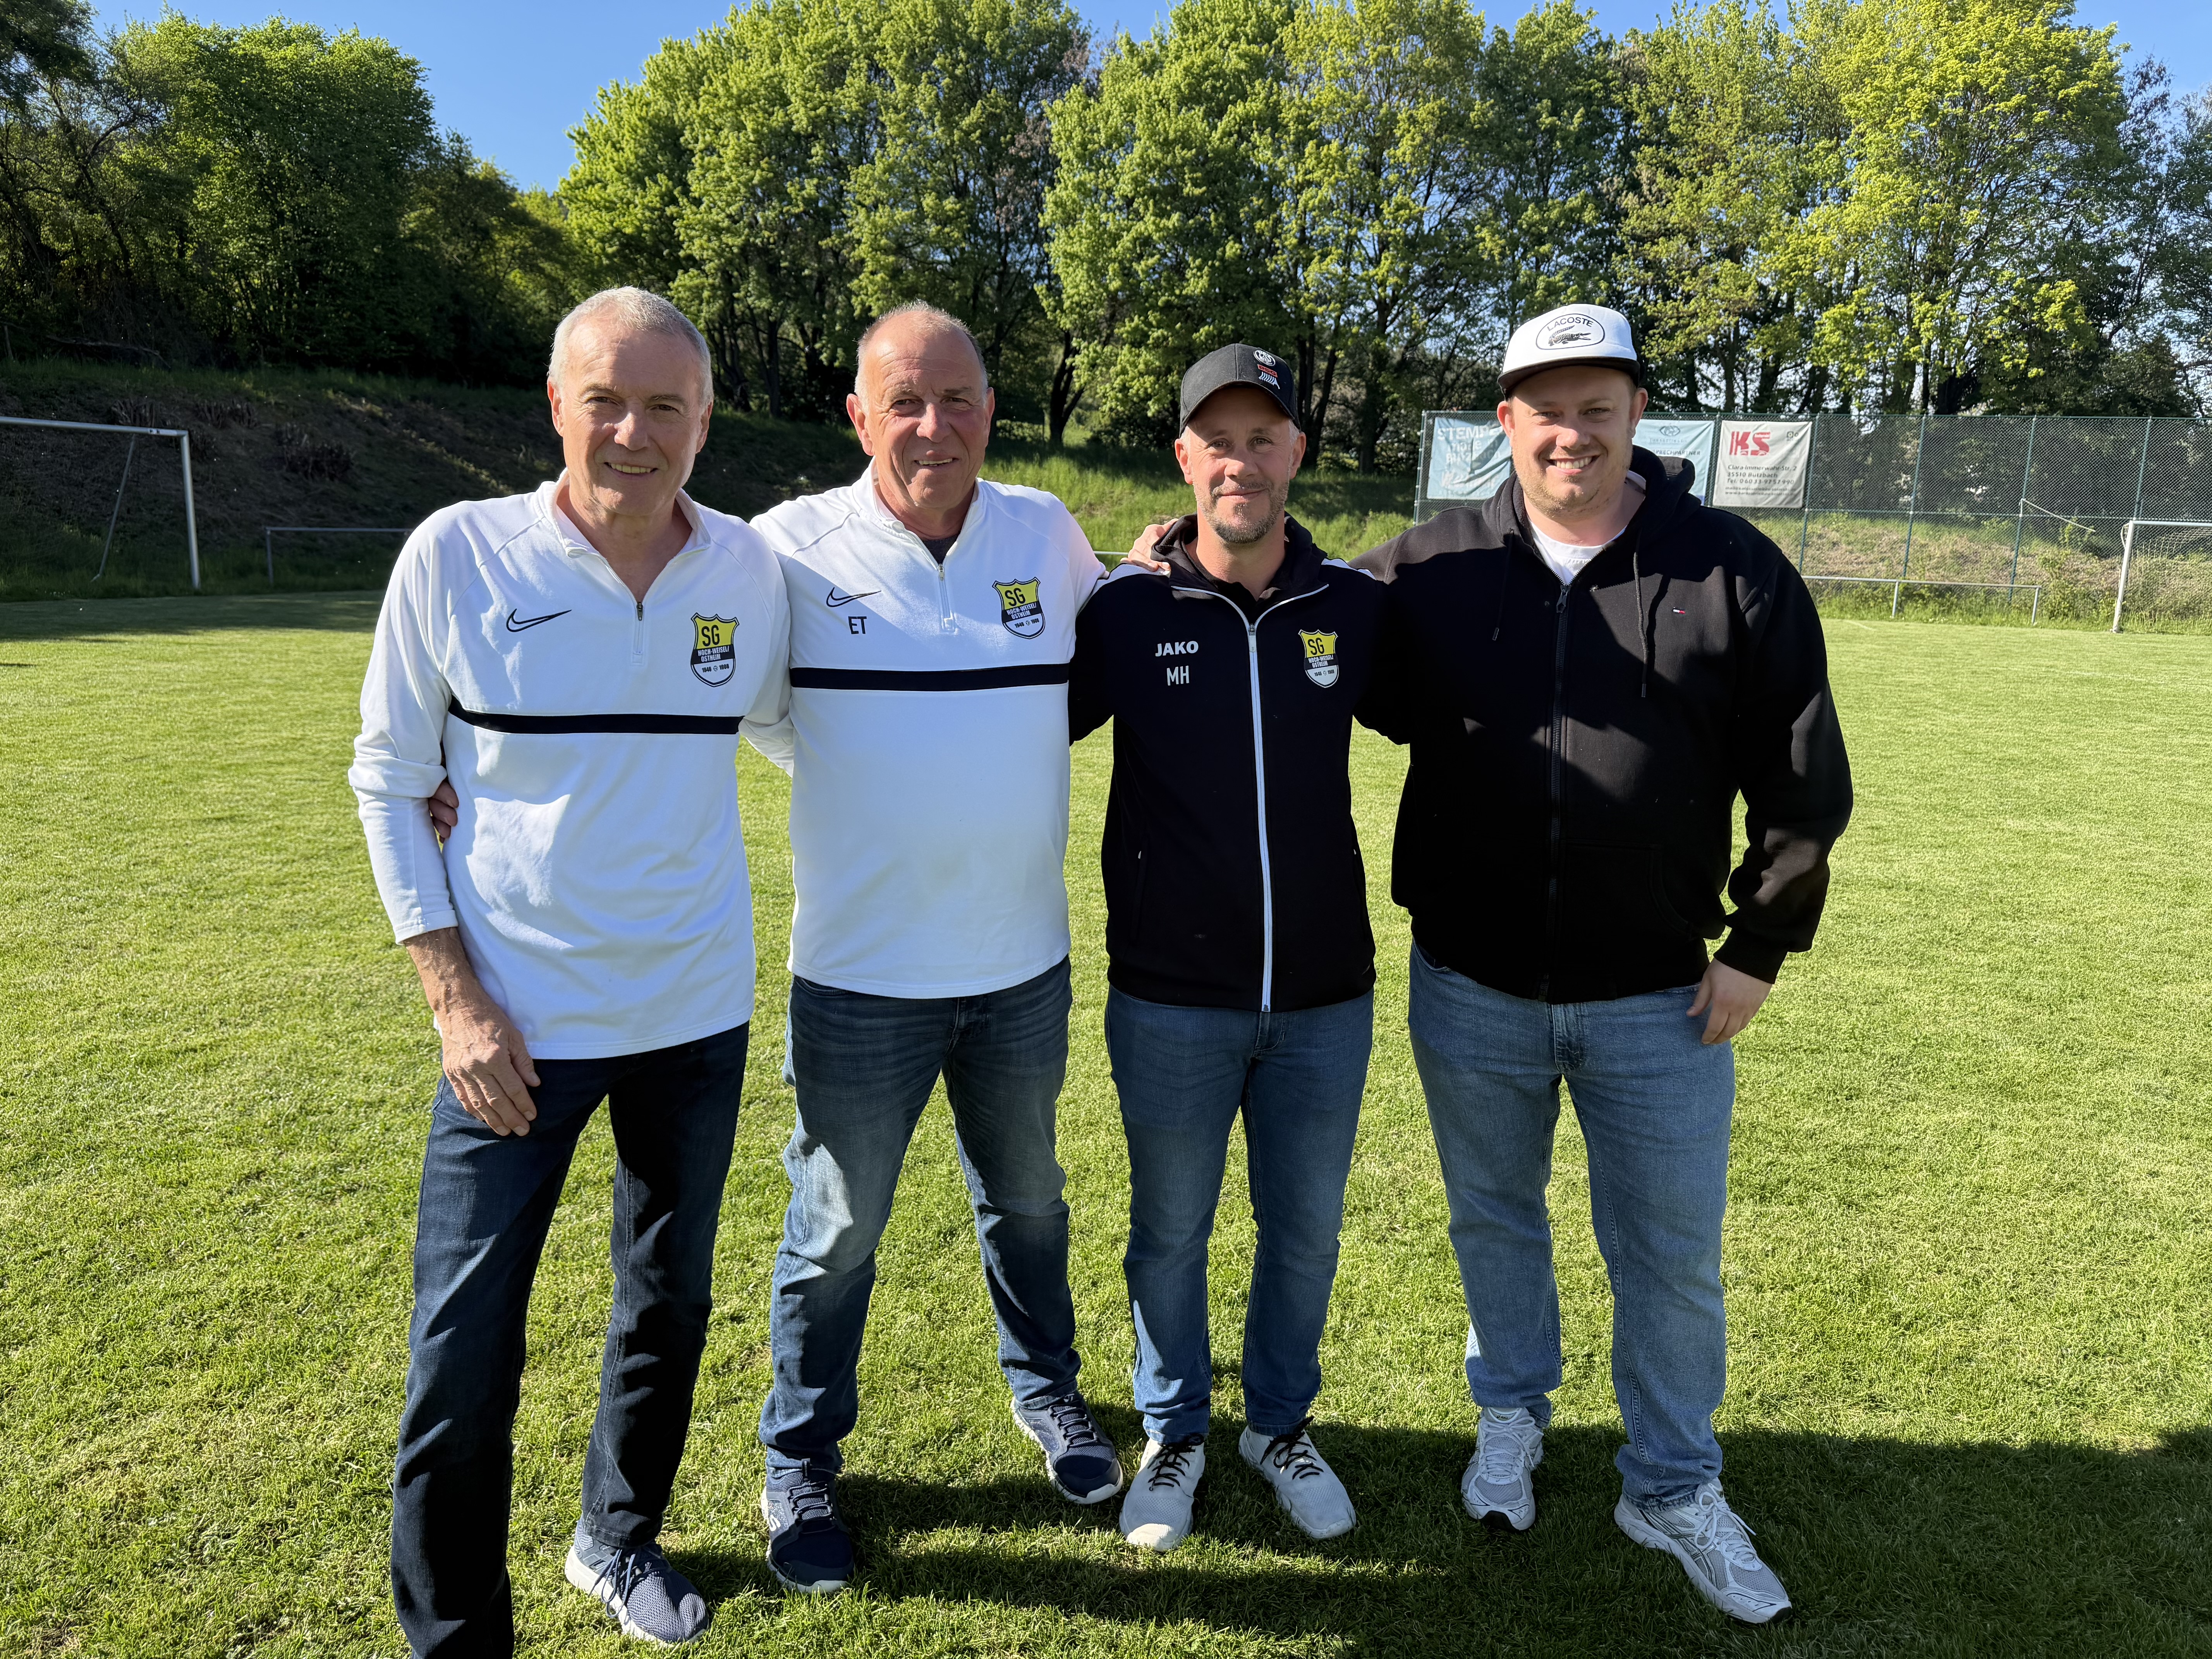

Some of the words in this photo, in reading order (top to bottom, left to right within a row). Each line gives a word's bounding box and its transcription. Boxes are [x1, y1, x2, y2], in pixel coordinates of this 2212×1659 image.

[1547, 317, 1594, 331] LACOSTE
[1729, 431, 1771, 456] KS
[1005, 587, 1025, 606] SG
[1011, 610, 1031, 619] OSTHEIM
[848, 616, 867, 634] ET
[701, 625, 720, 646] SG
[698, 646, 730, 656] HOCH-WEISEL/
[1155, 641, 1199, 657] JAKO
[1308, 637, 1324, 655] SG
[701, 654, 721, 662] OSTHEIM
[1167, 665, 1189, 686] MH
